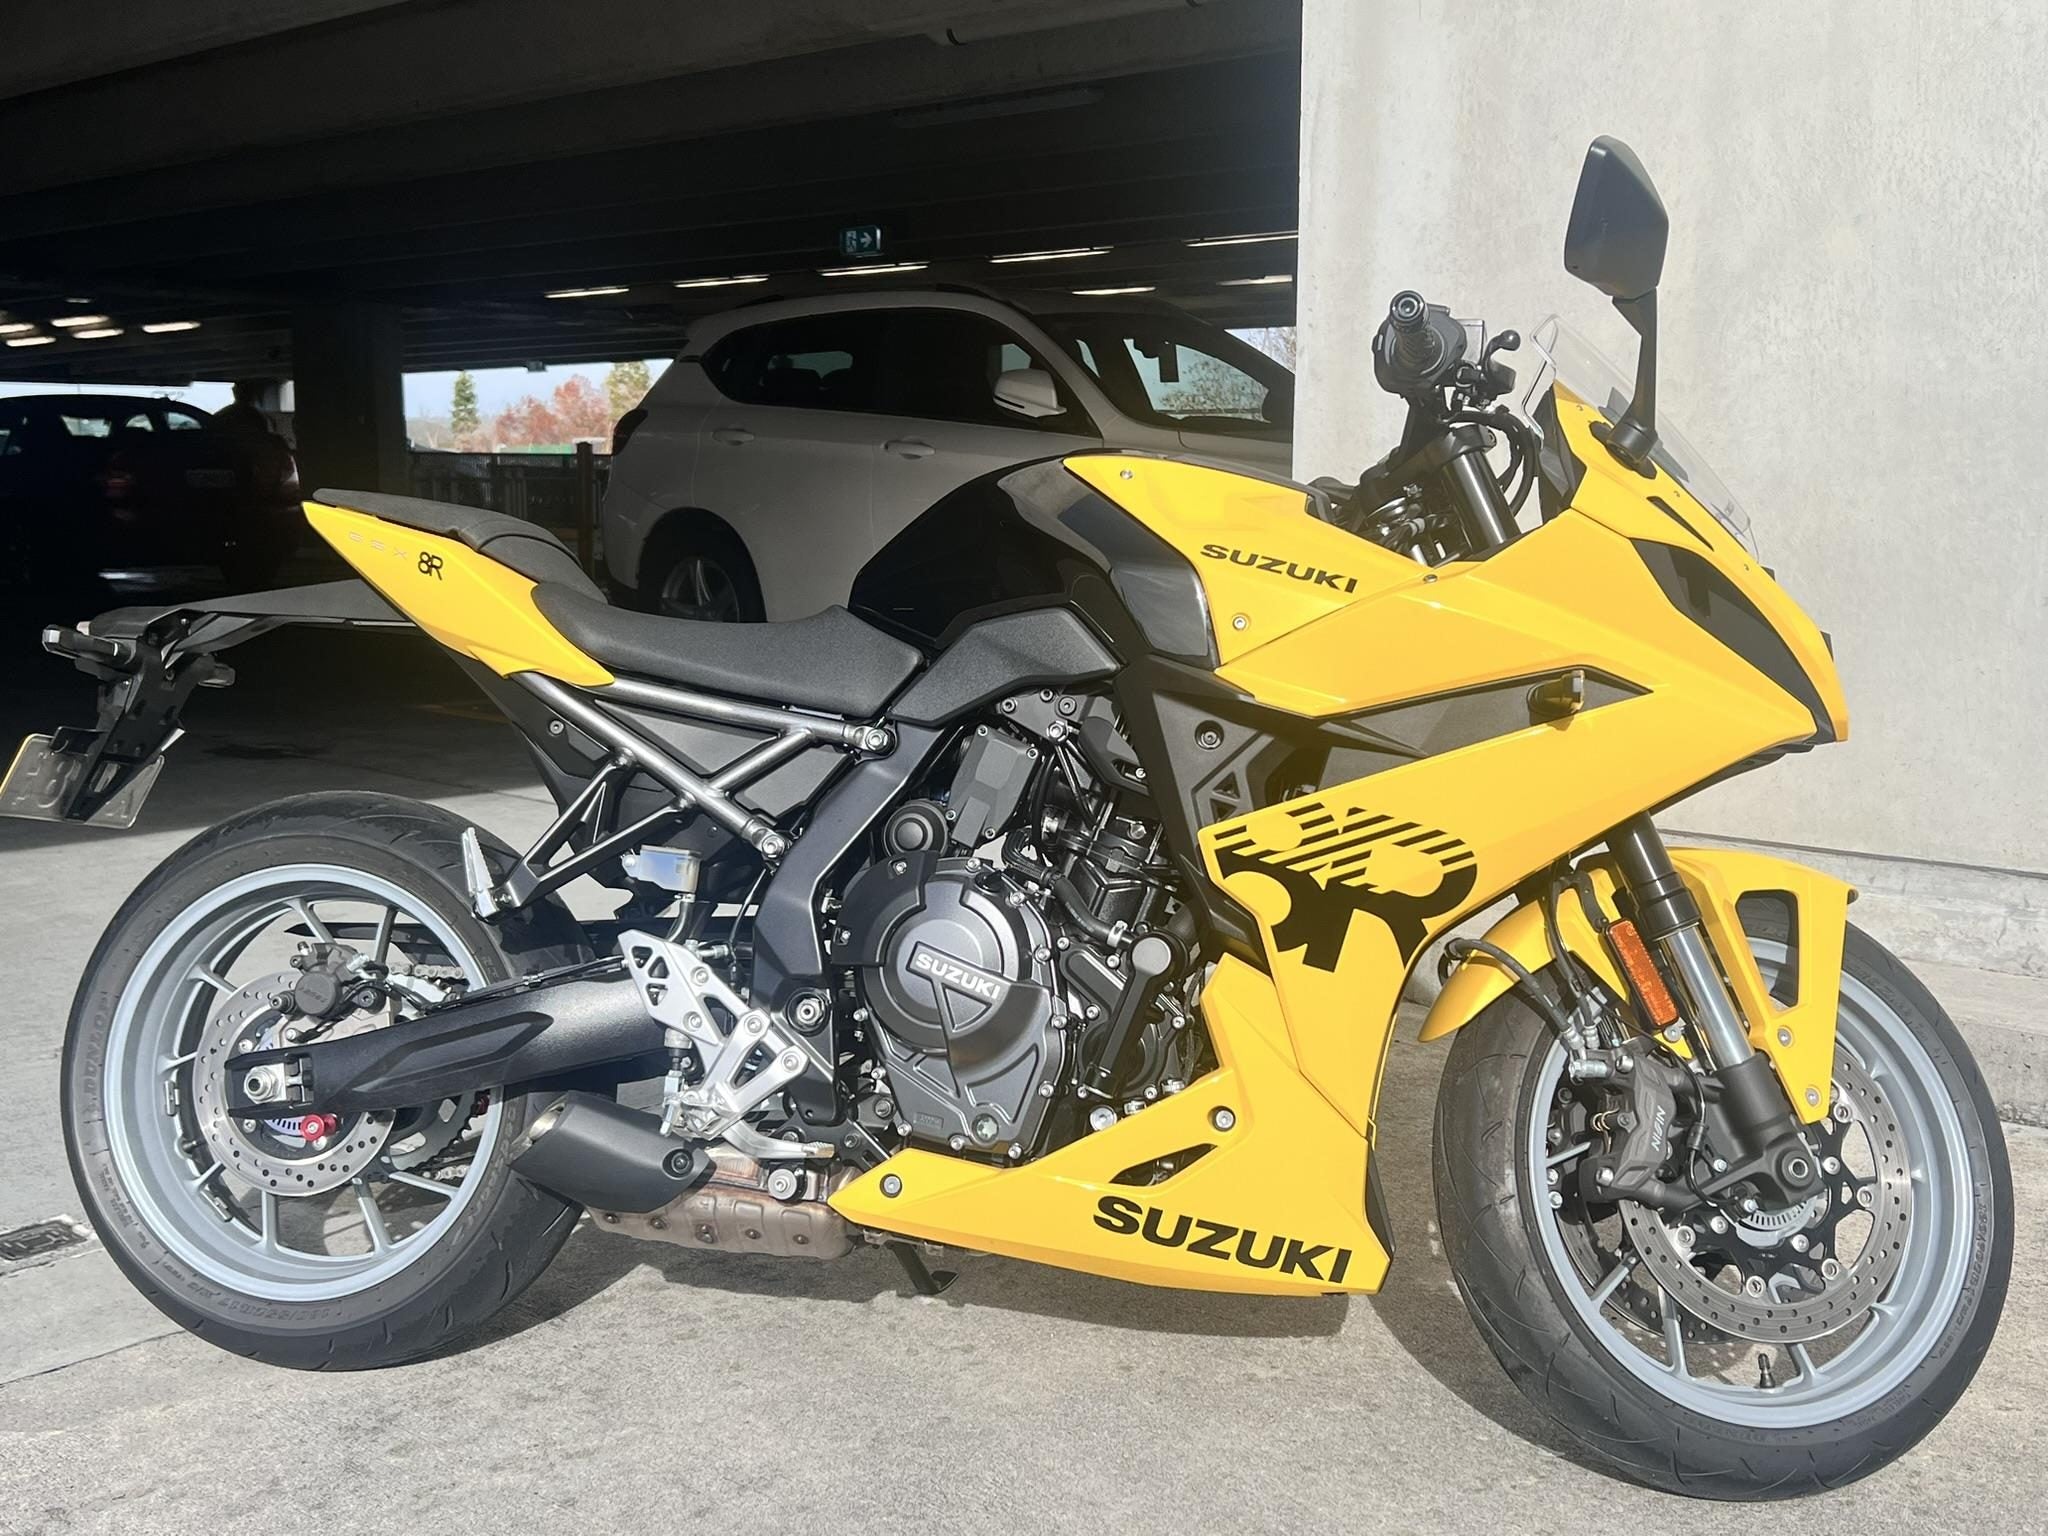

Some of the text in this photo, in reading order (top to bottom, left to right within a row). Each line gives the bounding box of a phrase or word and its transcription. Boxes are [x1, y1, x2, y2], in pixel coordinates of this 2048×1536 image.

[418, 551, 444, 581] 8R
[1200, 544, 1358, 594] SUZUKI
[915, 953, 1001, 1000] SUZUKI
[1093, 1195, 1353, 1284] SUZUKI
